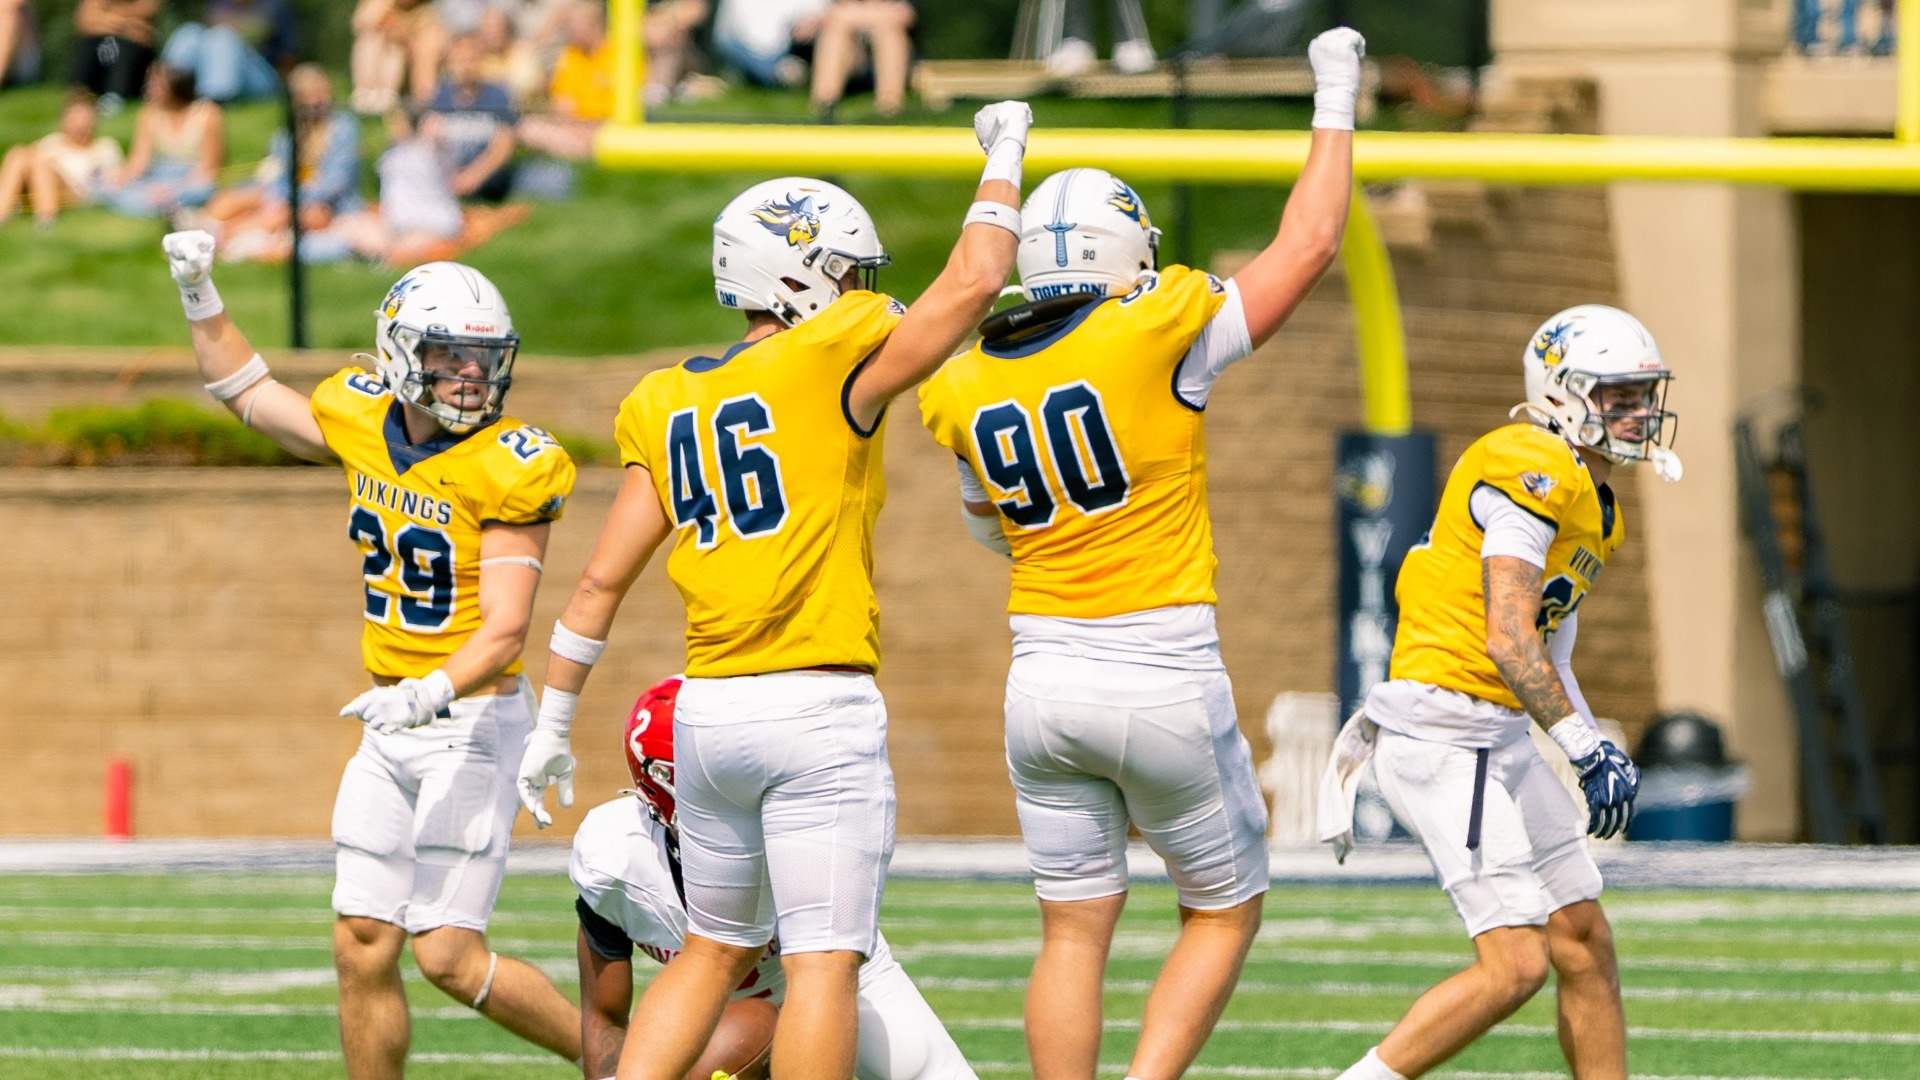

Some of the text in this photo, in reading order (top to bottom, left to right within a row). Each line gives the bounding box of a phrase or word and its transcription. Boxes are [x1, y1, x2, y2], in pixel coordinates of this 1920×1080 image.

[718, 256, 727, 268] 46
[1082, 248, 1096, 261] 90
[1029, 283, 1074, 301] FIGHT
[465, 323, 495, 332] Riddell
[665, 391, 790, 550] 46
[970, 378, 1131, 530] 90
[355, 471, 453, 526] VIKINGS
[348, 501, 457, 634] 29
[629, 708, 652, 766] 2
